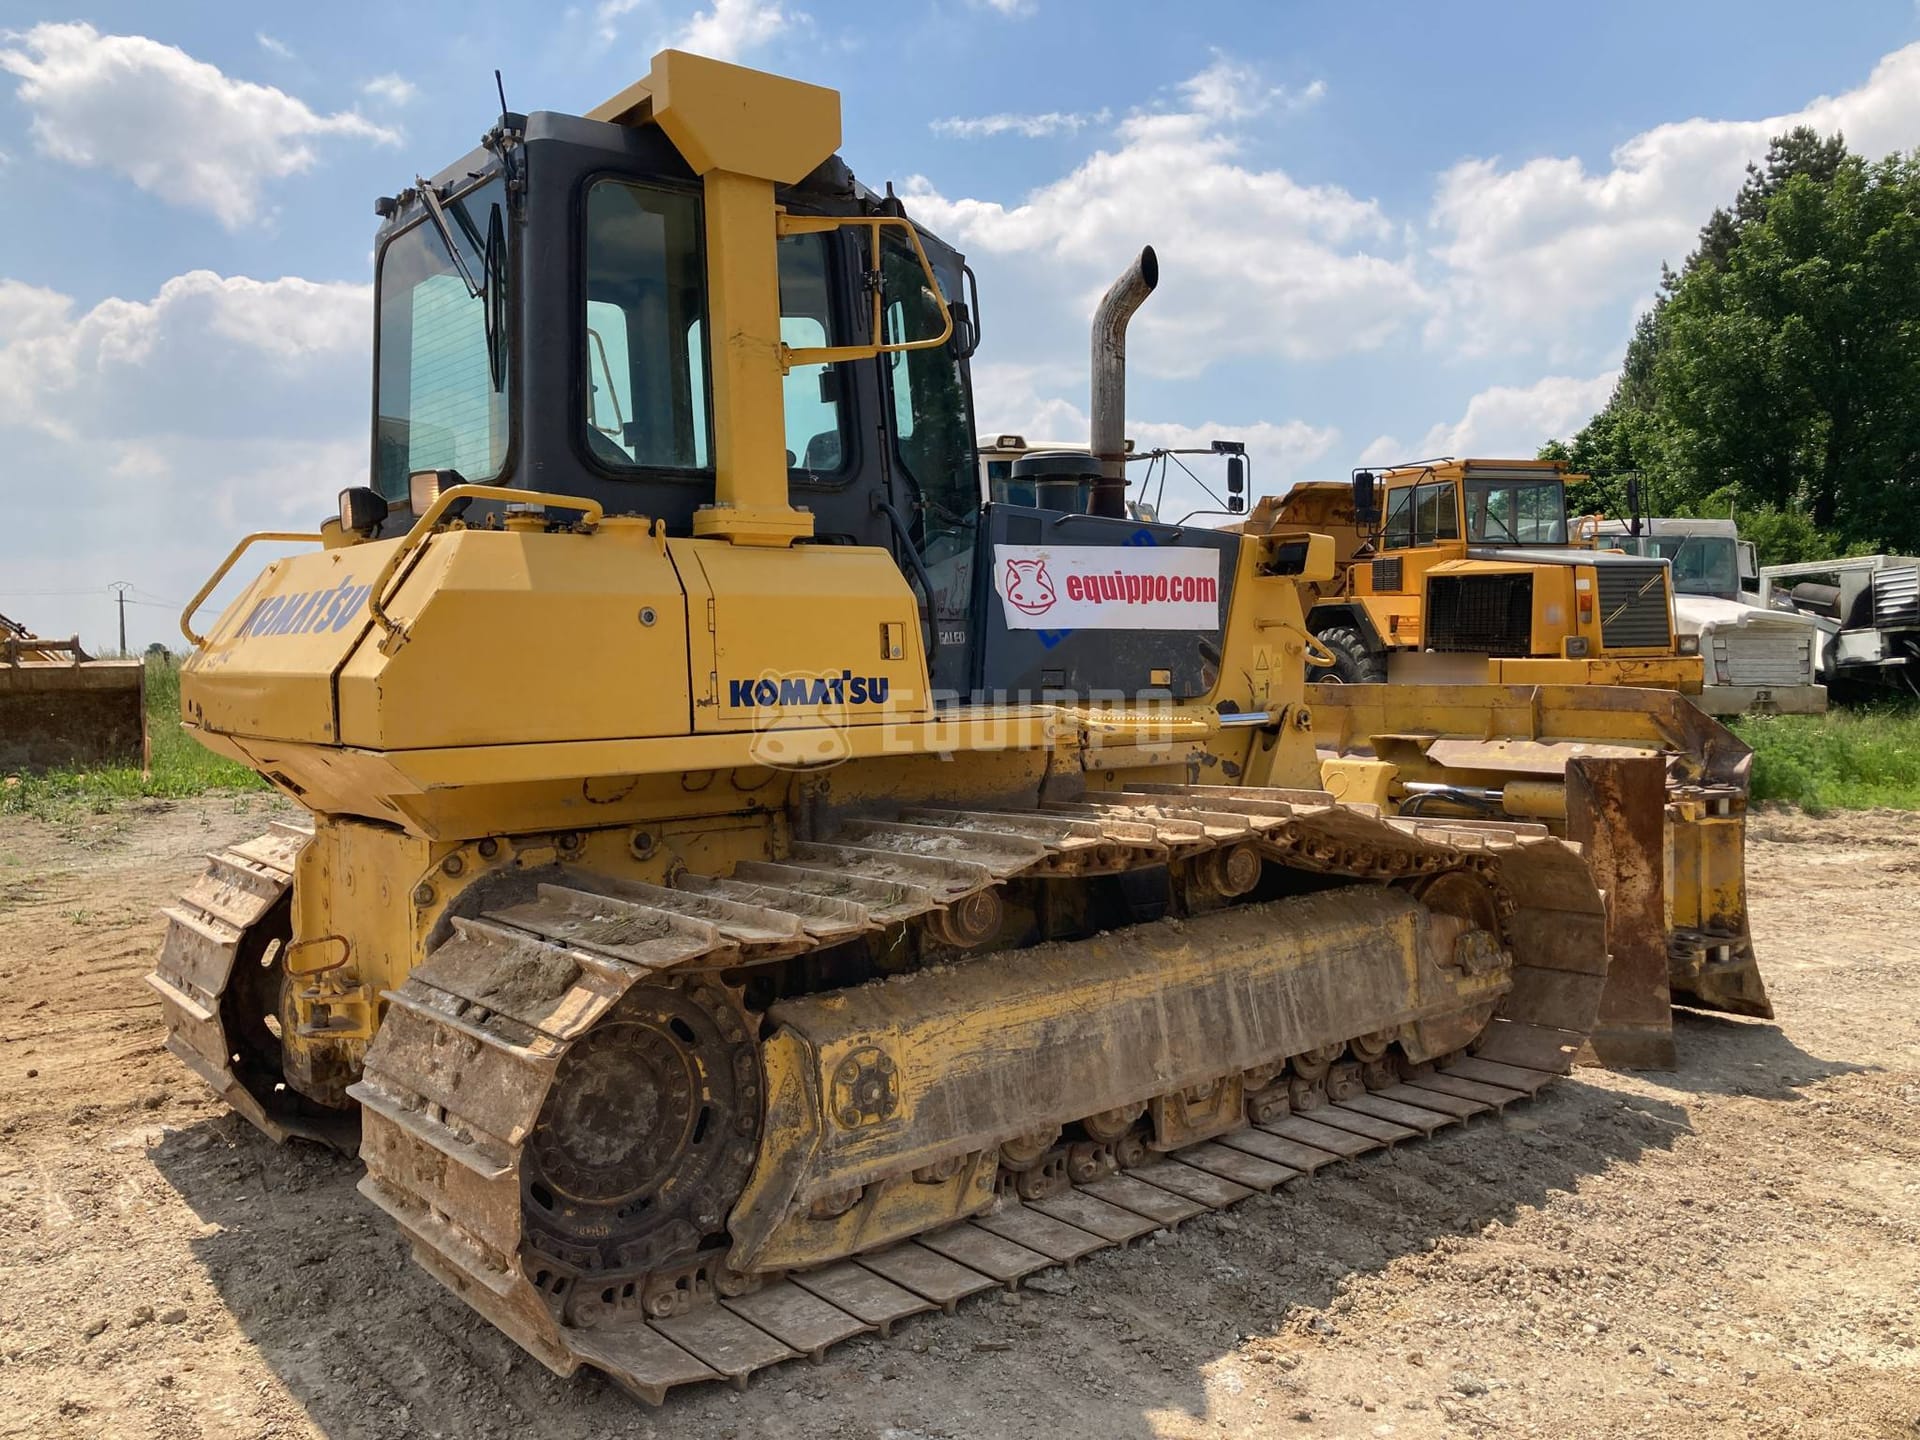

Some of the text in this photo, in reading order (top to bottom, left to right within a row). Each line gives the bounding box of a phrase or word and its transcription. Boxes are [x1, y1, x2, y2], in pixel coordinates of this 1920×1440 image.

[1066, 570, 1217, 604] equippo.com
[234, 574, 373, 638] KOMATSU
[729, 670, 889, 707] KOMATSU
